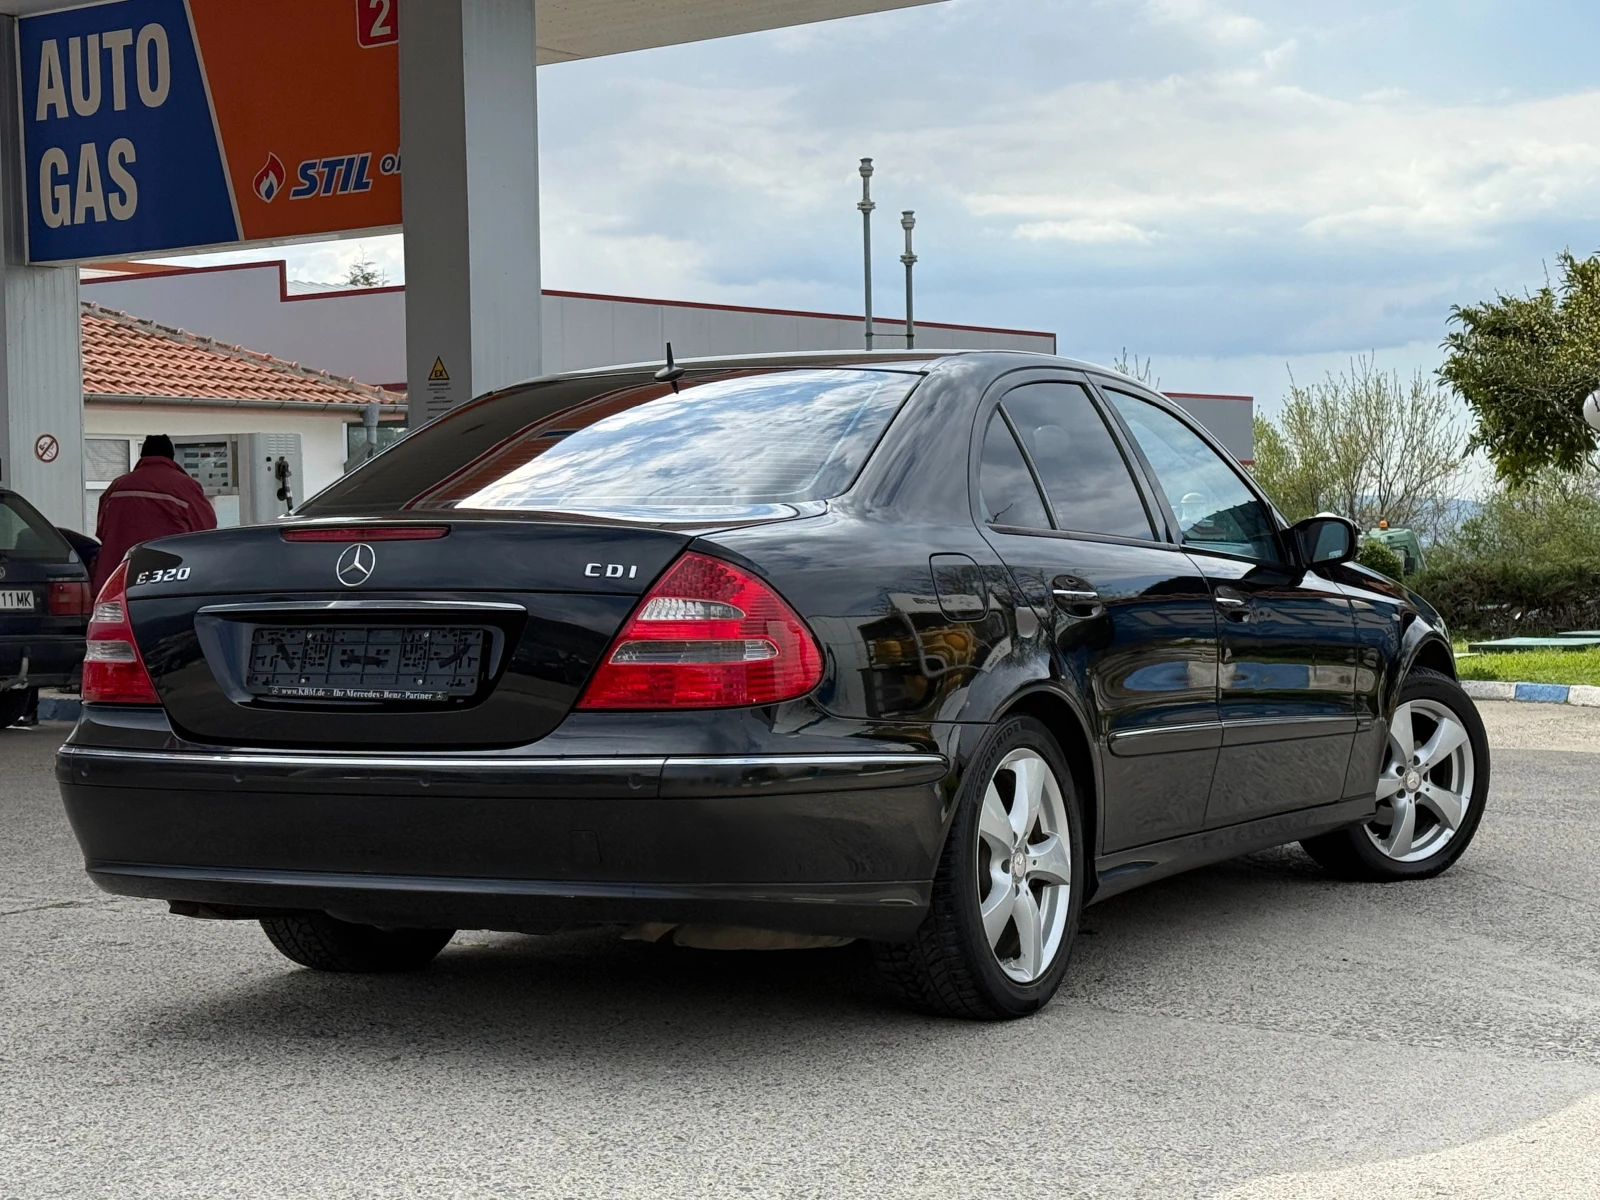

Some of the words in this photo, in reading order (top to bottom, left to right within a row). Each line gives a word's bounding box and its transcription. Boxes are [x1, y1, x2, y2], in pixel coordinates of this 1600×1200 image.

[369, 0, 391, 37] 2
[35, 22, 171, 122] AUTO
[39, 137, 138, 229] GAS
[289, 152, 373, 200] STIL
[434, 370, 444, 378] EX
[584, 563, 637, 579] CDI
[333, 689, 344, 697] Ihr
[975, 721, 1020, 800] GOODRIDE
